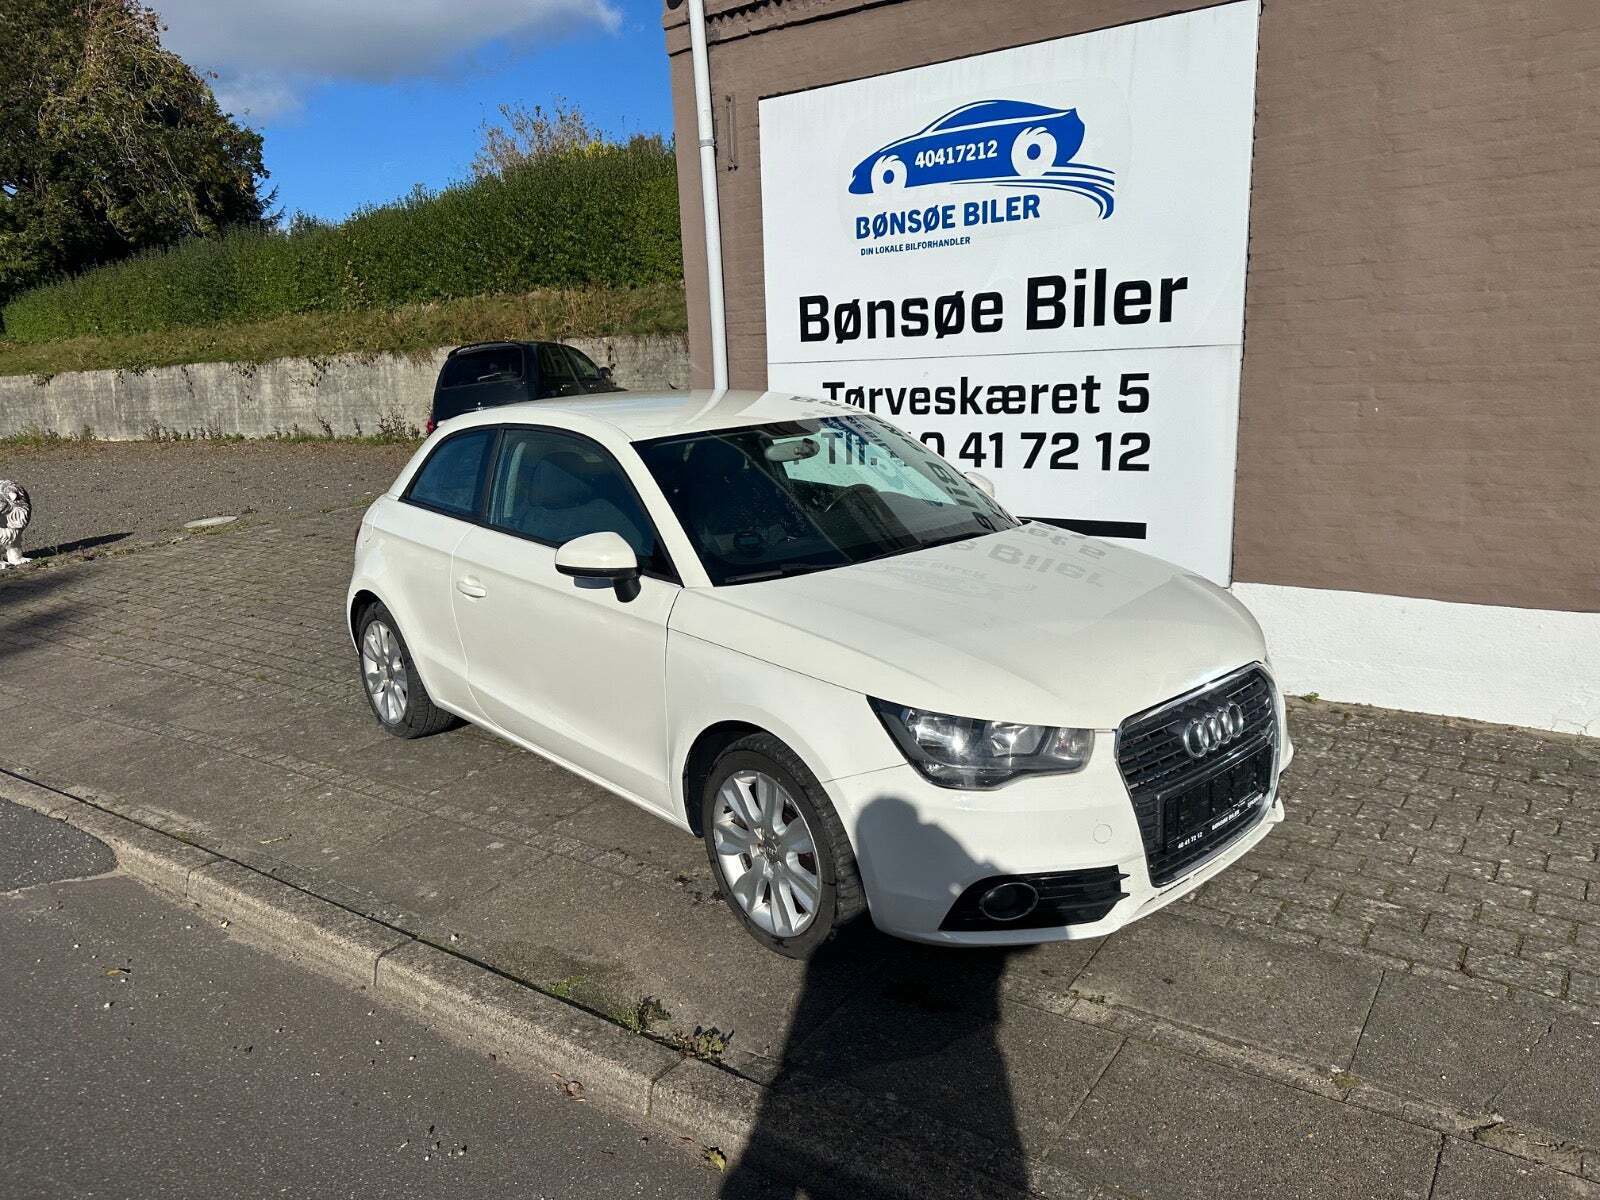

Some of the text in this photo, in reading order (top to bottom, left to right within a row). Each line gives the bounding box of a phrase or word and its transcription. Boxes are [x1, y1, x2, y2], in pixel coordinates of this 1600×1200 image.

[914, 139, 998, 169] 40417212
[855, 194, 1041, 240] BØNSØE BILER
[860, 236, 971, 256] DIN LOKALE BILFORHANDLER
[799, 268, 1189, 345] Bønsøe Biler
[821, 372, 1150, 415] Tørveskæret 5
[958, 432, 1004, 469] 41
[1020, 432, 1079, 471] 72
[1095, 432, 1151, 472] 12
